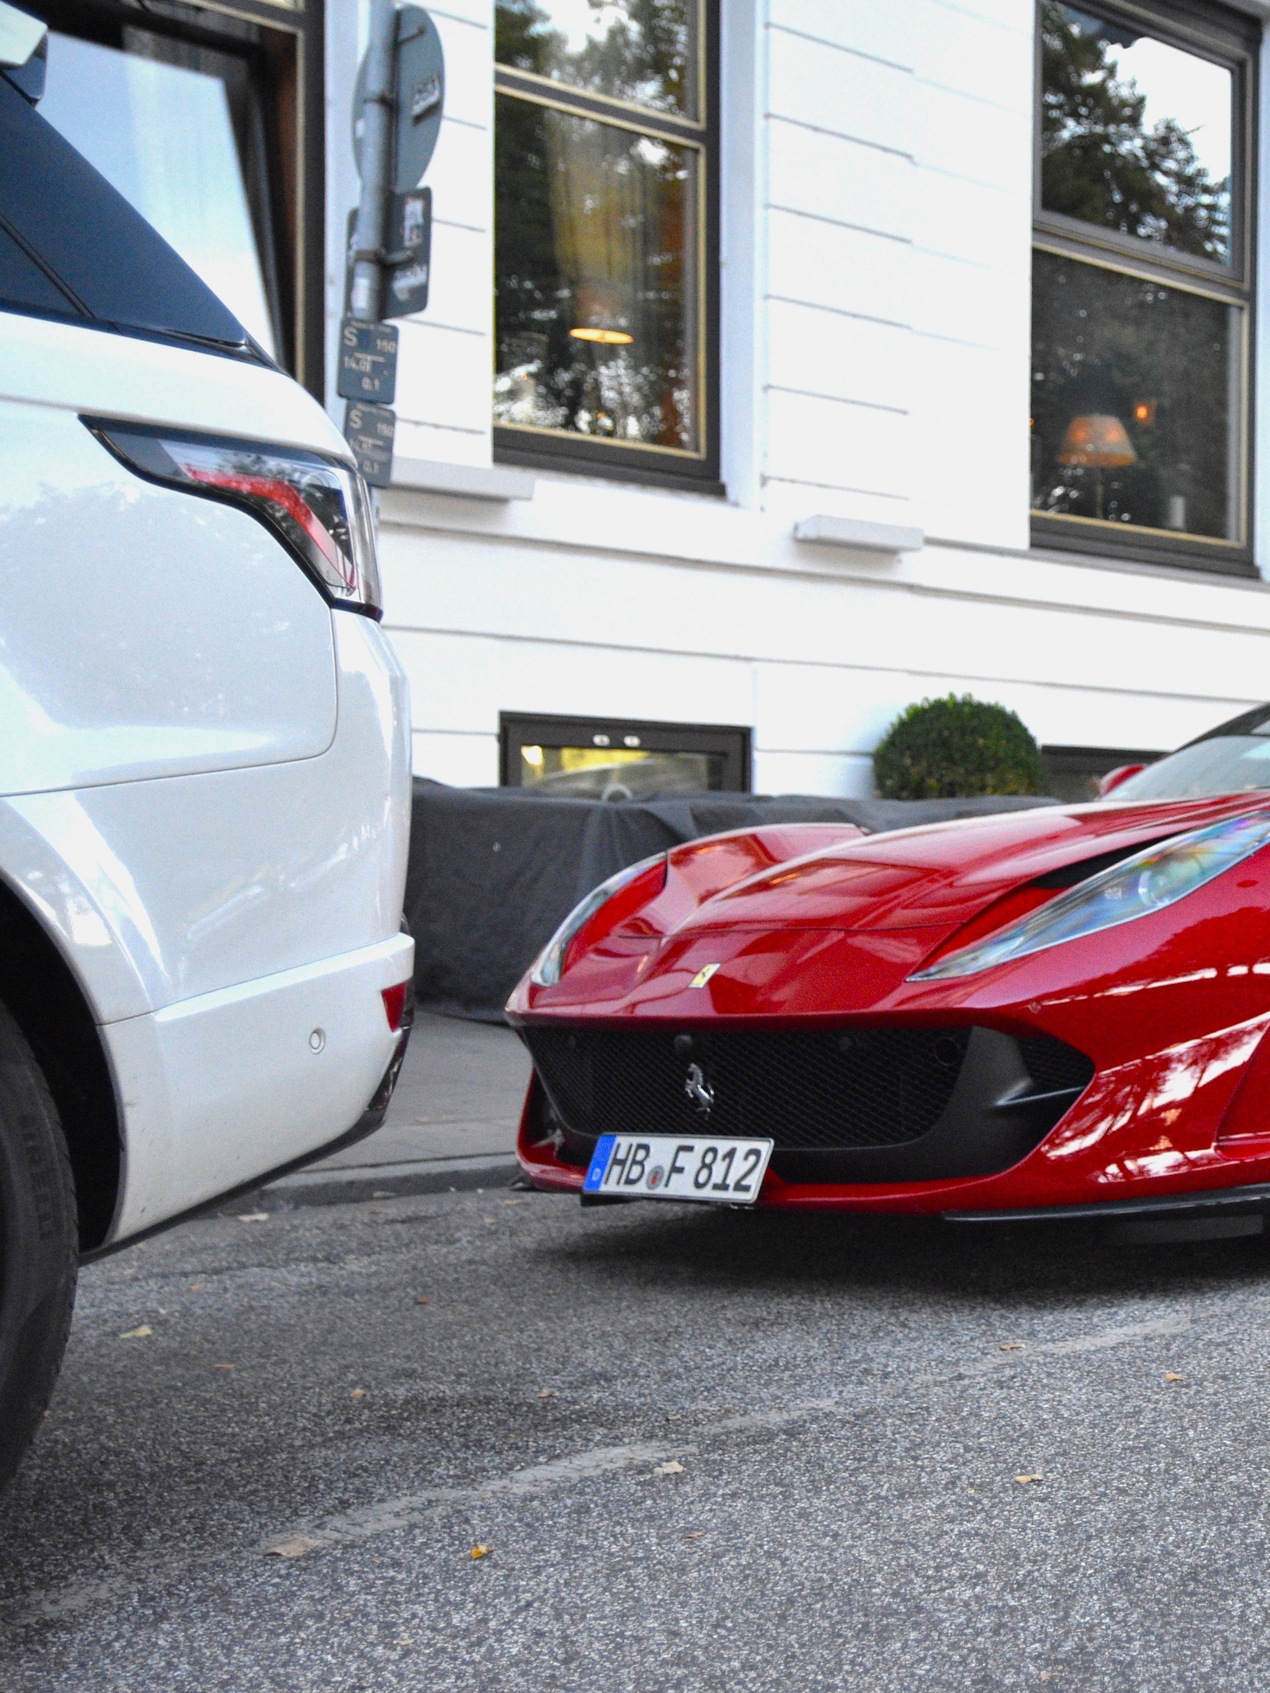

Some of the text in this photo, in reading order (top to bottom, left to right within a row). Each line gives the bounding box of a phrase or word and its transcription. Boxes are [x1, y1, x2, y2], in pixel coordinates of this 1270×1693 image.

[604, 1142, 651, 1186] HB
[664, 1144, 695, 1188] F
[693, 1146, 762, 1193] 812
